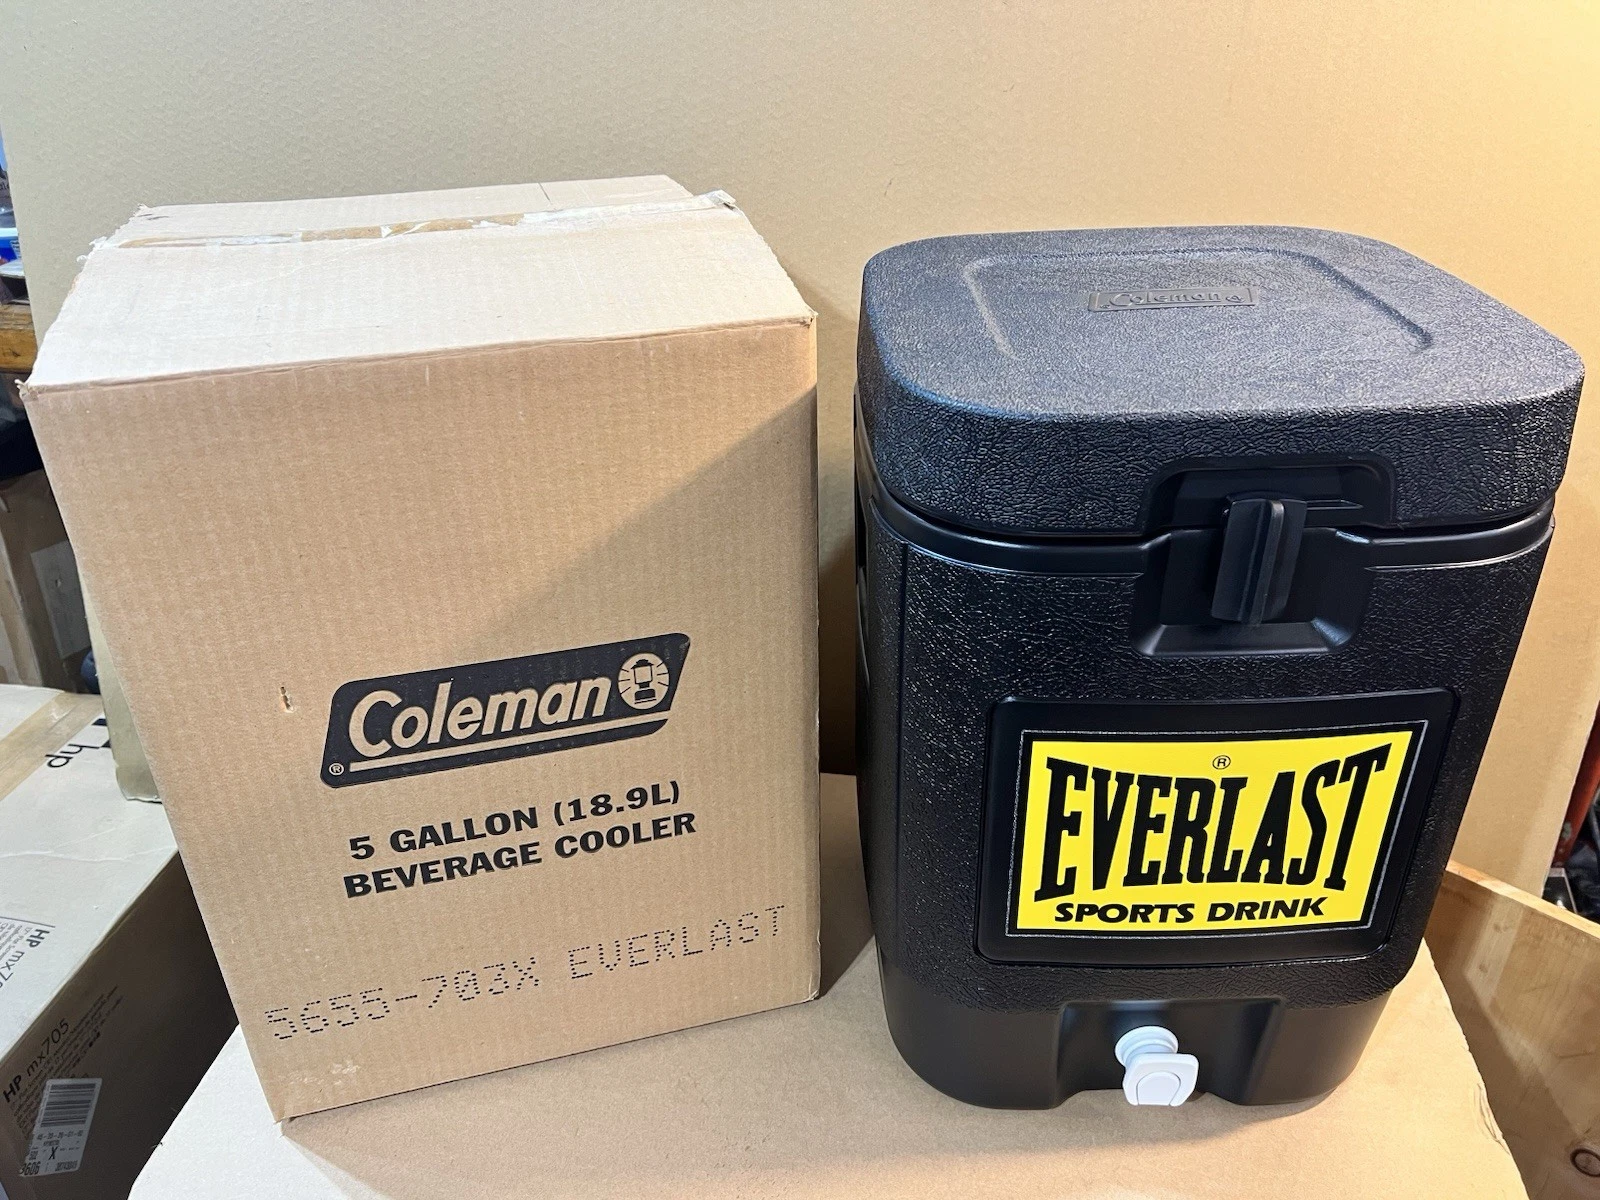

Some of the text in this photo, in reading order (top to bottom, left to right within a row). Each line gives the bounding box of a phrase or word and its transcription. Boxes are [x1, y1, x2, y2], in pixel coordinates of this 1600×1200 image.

[1108, 291, 1221, 307] Coleman
[45, 743, 100, 768] hp
[348, 677, 612, 758] Coleman
[343, 812, 697, 899] BEVERAGE COOLER
[349, 780, 680, 860] 5 GALLON (18.9L)
[1033, 743, 1392, 902] EVERLAST
[26, 928, 50, 948] HP
[567, 904, 786, 980] EVERLAST
[1054, 896, 1329, 924] SPORTS DRINK
[0, 950, 25, 988] mx7
[3, 1017, 70, 1103] HP mx705
